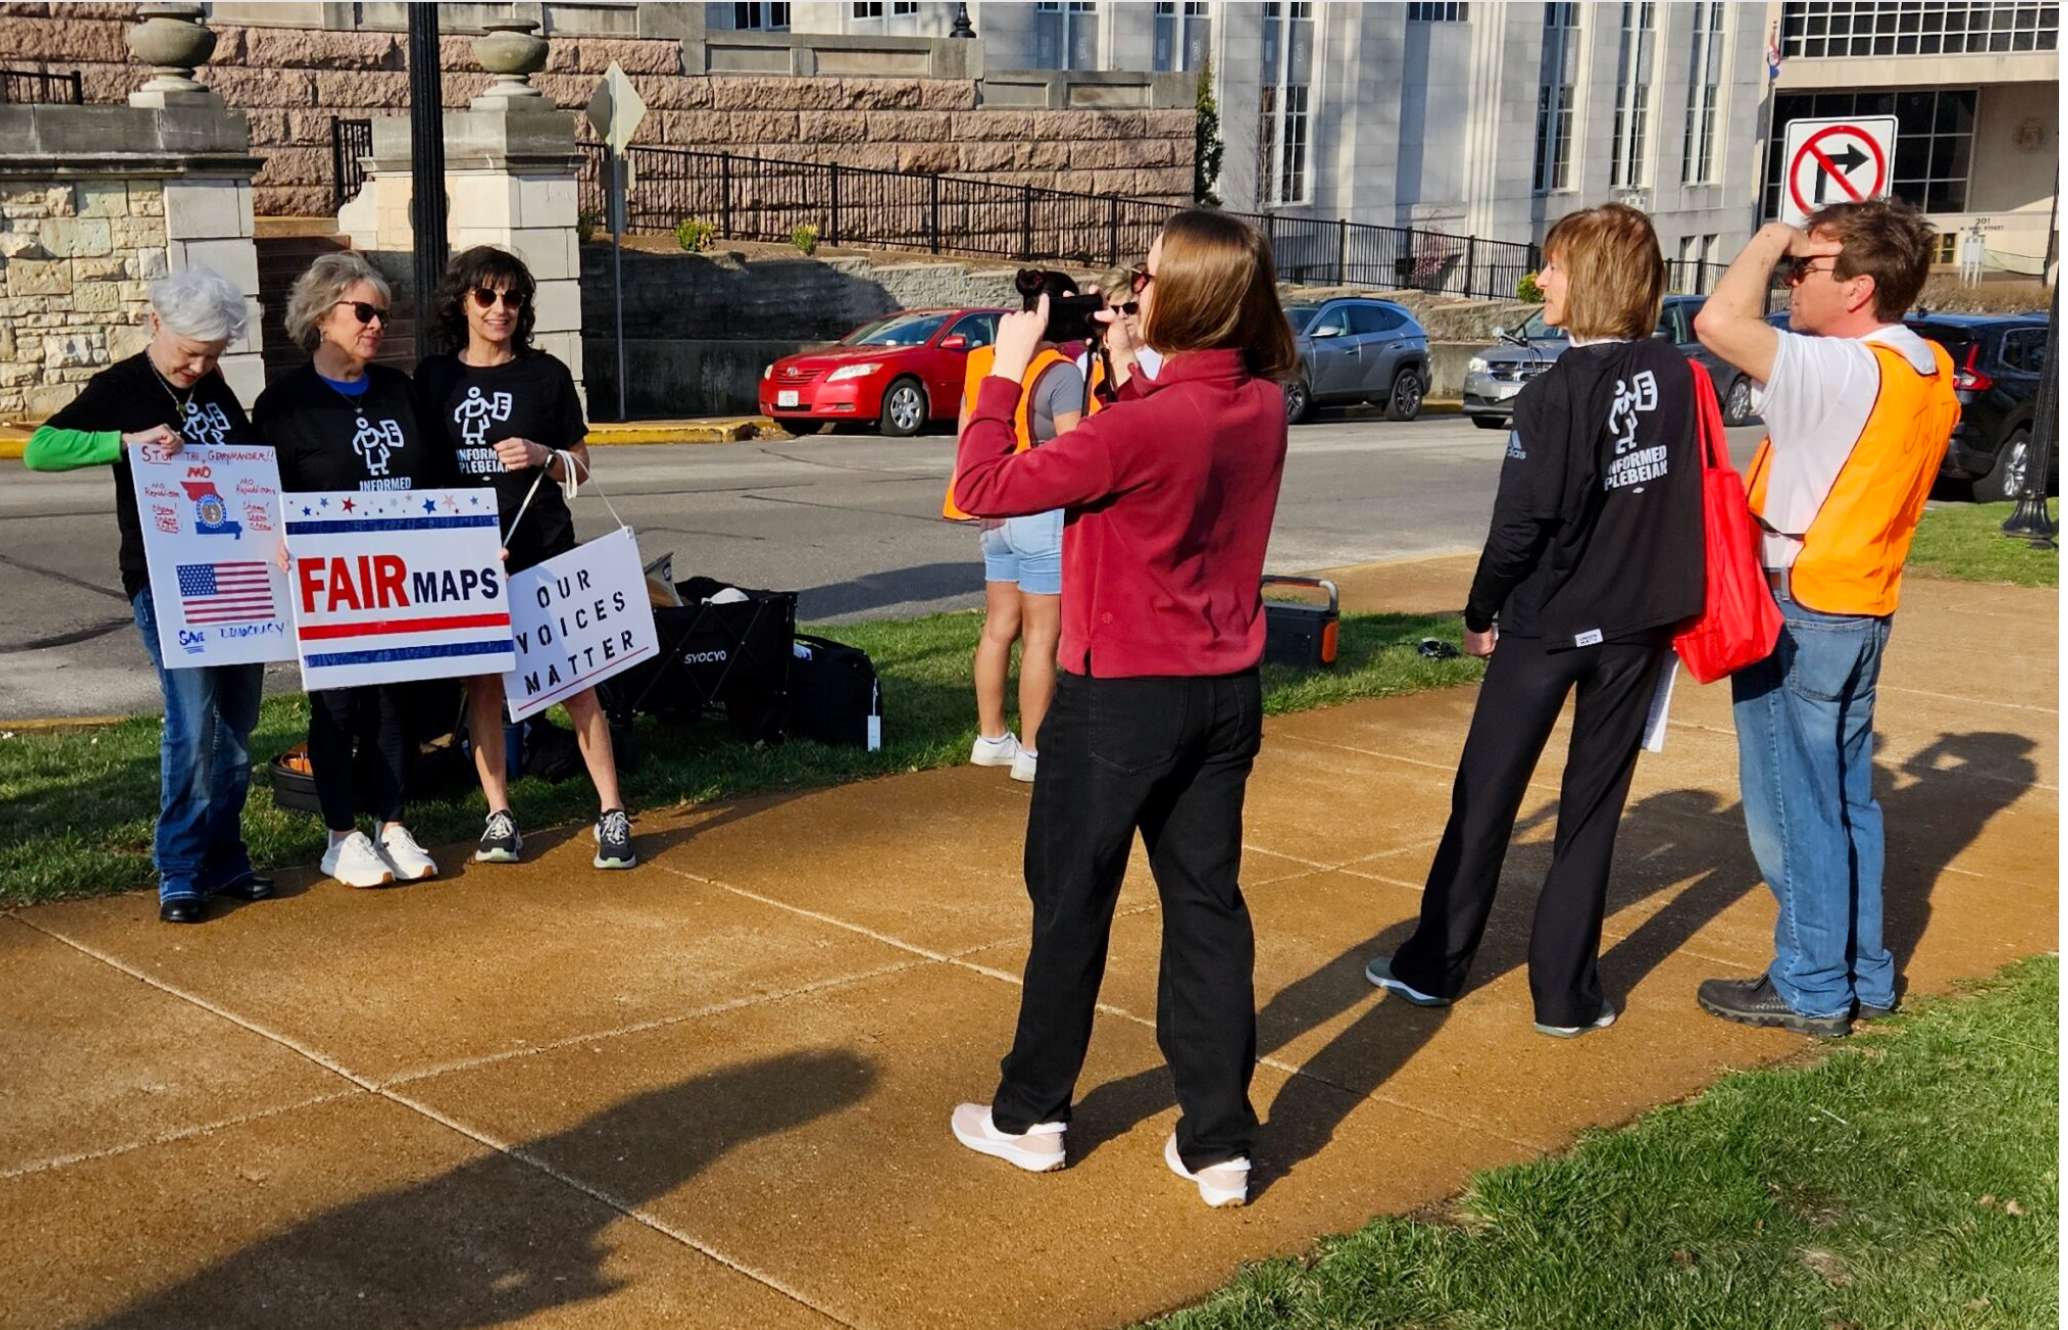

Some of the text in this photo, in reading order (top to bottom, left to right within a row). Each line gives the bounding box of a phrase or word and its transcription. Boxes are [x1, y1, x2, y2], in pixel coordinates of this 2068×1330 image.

[456, 447, 498, 461] INFORM
[1608, 445, 1667, 475] INFORMED
[359, 477, 411, 492] INFORMED
[1604, 460, 1668, 491] PLEBEIAN
[297, 554, 499, 613] FAIR MAPS
[536, 569, 591, 608] OUR
[516, 591, 625, 654] VOICES
[524, 630, 635, 695] MATTER
[684, 650, 727, 664] SYOCYO
